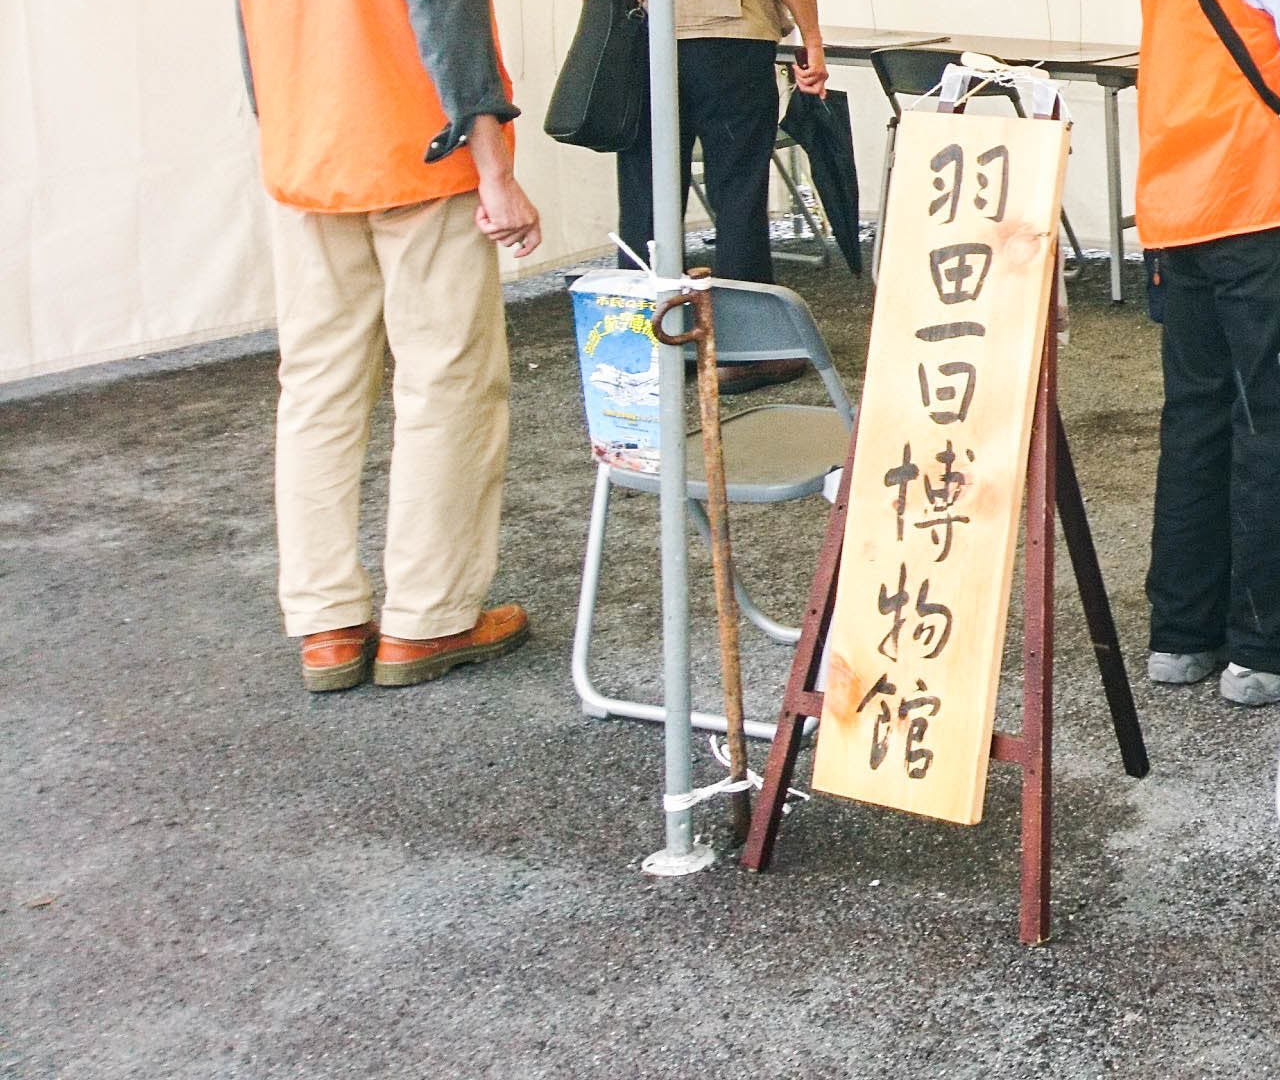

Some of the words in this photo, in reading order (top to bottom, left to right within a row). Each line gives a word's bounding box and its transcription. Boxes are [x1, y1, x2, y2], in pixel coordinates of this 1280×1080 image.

[858, 143, 1009, 780] 羽田一日博物館
